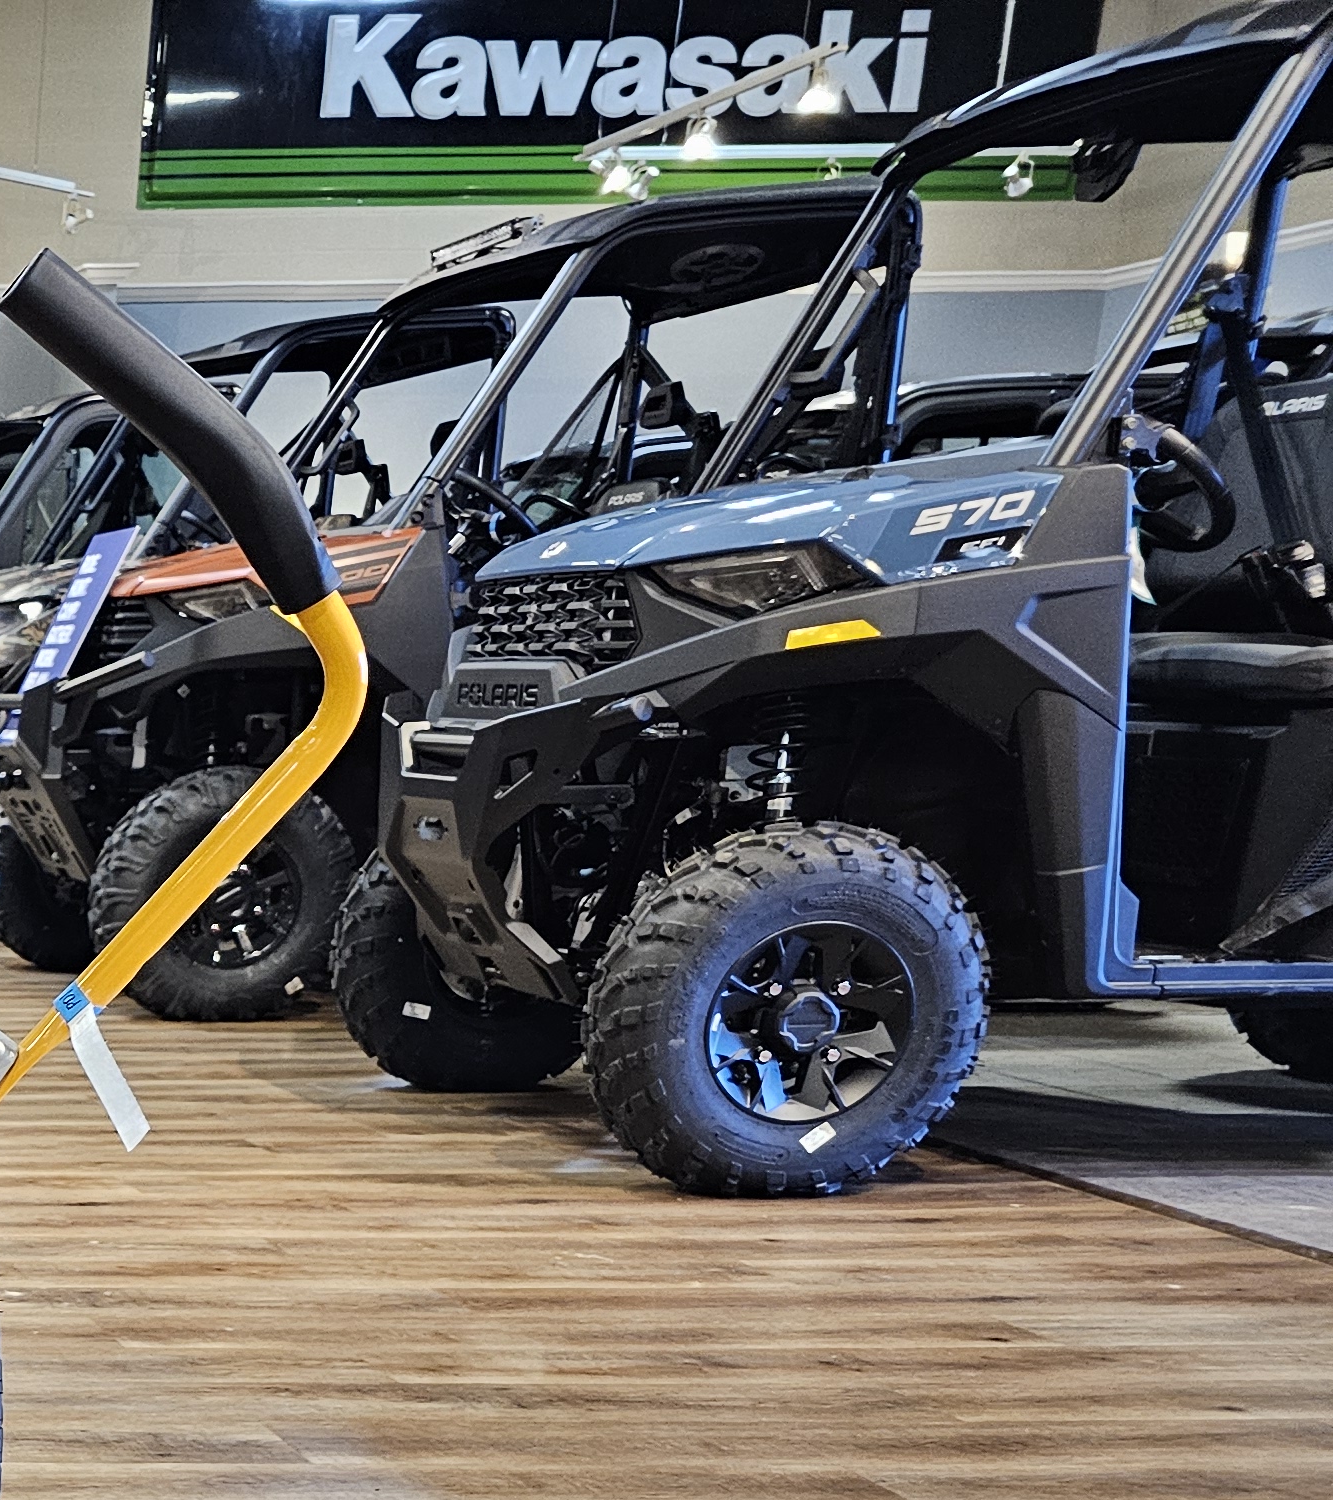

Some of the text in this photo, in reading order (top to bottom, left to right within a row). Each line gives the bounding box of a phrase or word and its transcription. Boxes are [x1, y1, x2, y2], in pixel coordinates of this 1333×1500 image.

[319, 8, 932, 120] Kawasaki
[909, 489, 1036, 536] 570
[340, 563, 390, 582] 00
[457, 682, 540, 708] POLARIS
